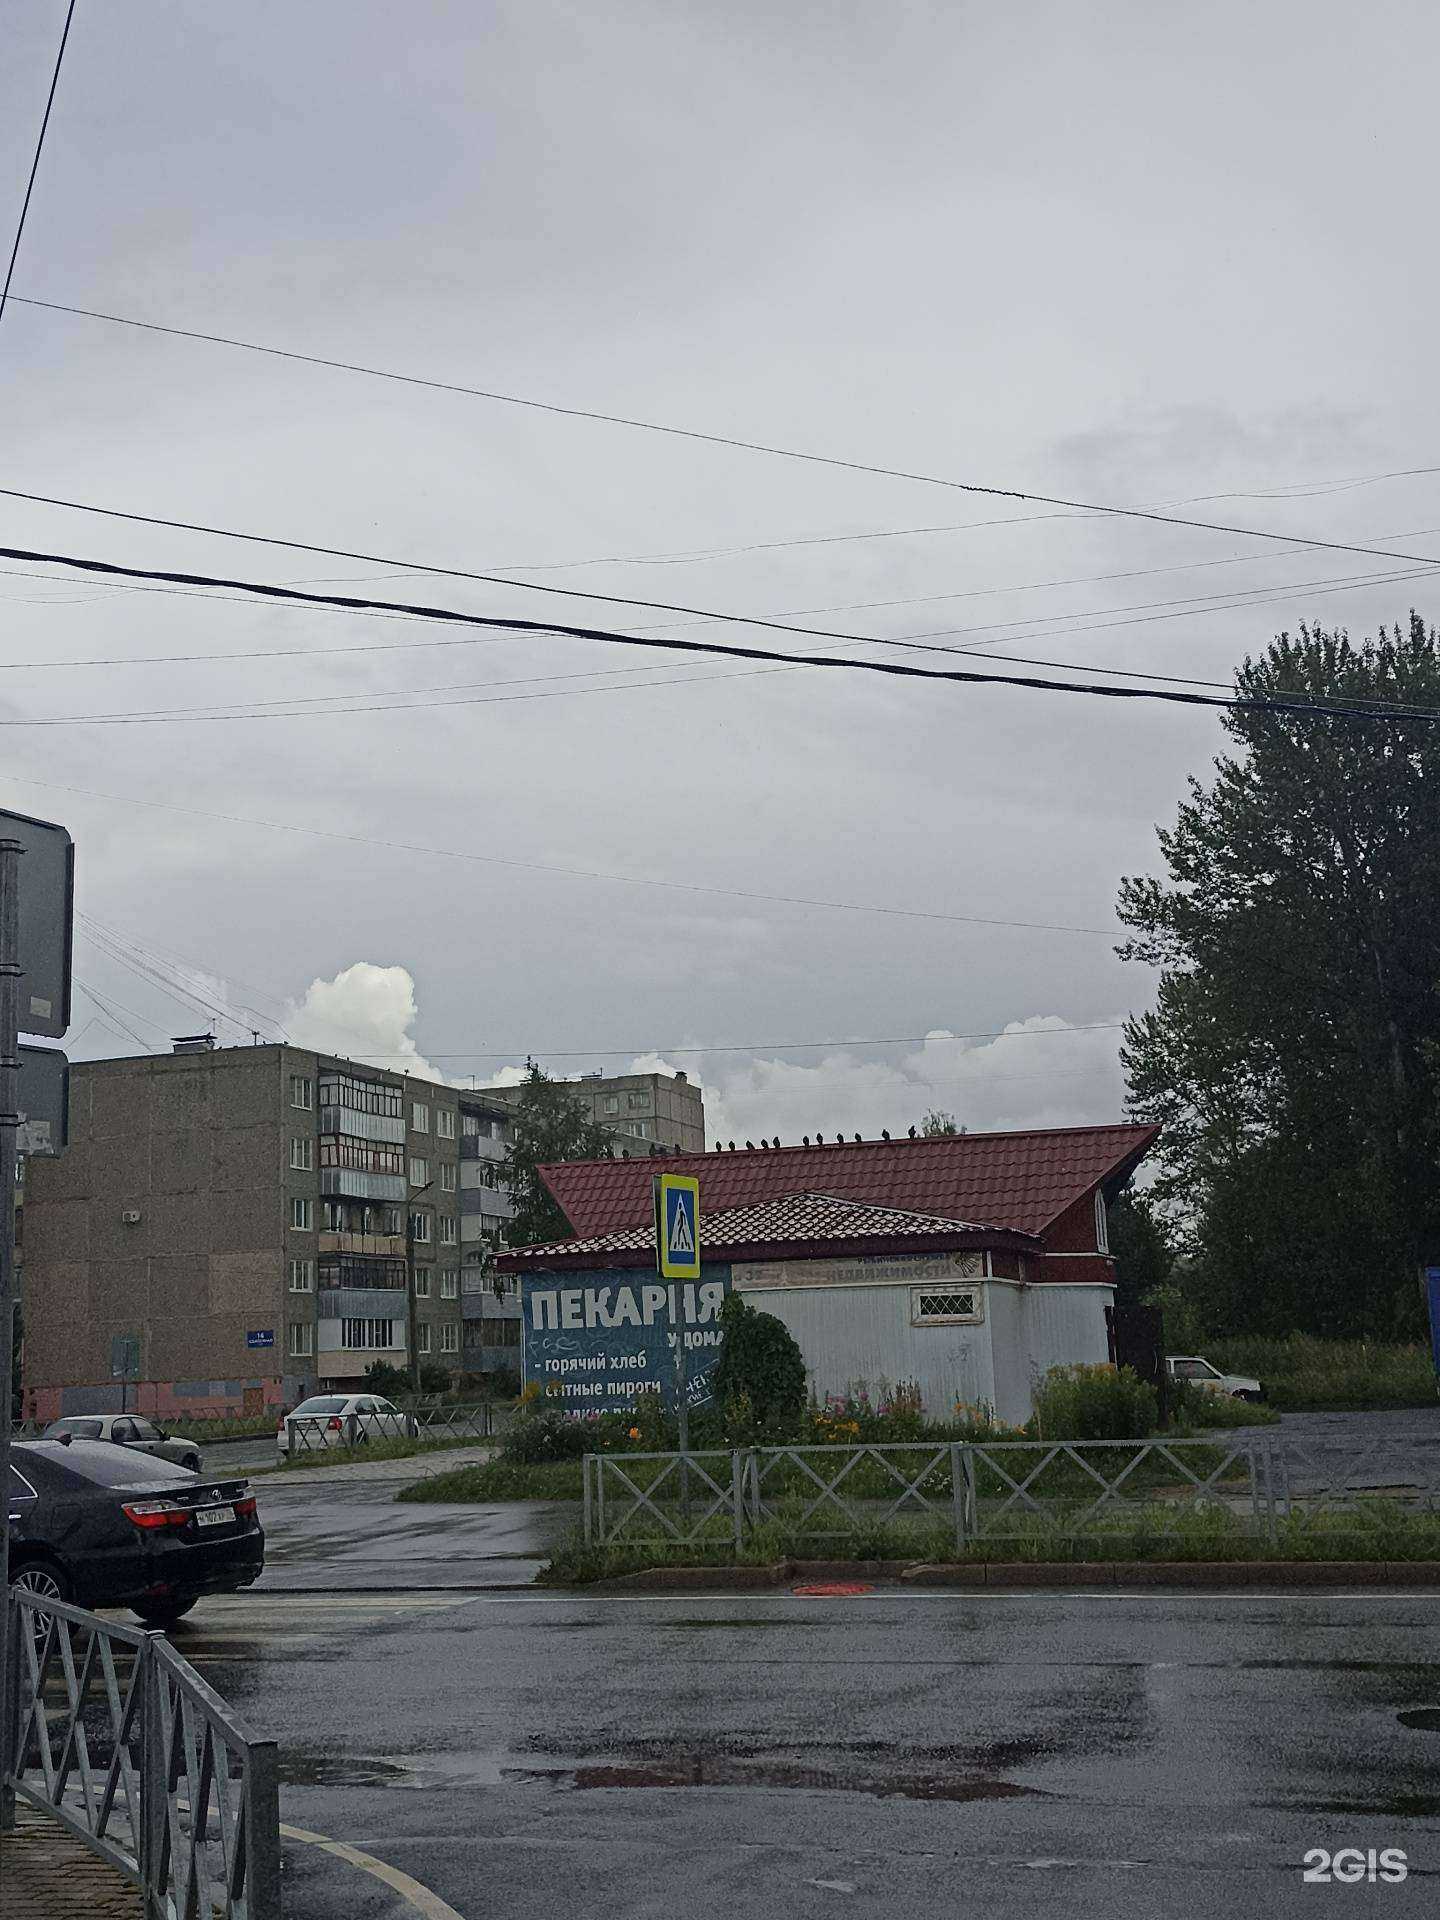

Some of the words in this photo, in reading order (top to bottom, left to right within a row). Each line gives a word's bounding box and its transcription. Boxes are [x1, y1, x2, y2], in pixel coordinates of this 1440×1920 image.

[531, 1282, 725, 1330] ПЕКАРНЯ
[545, 1352, 606, 1375] горячий
[610, 1350, 647, 1369] хлеб
[607, 1380, 662, 1399] пироги
